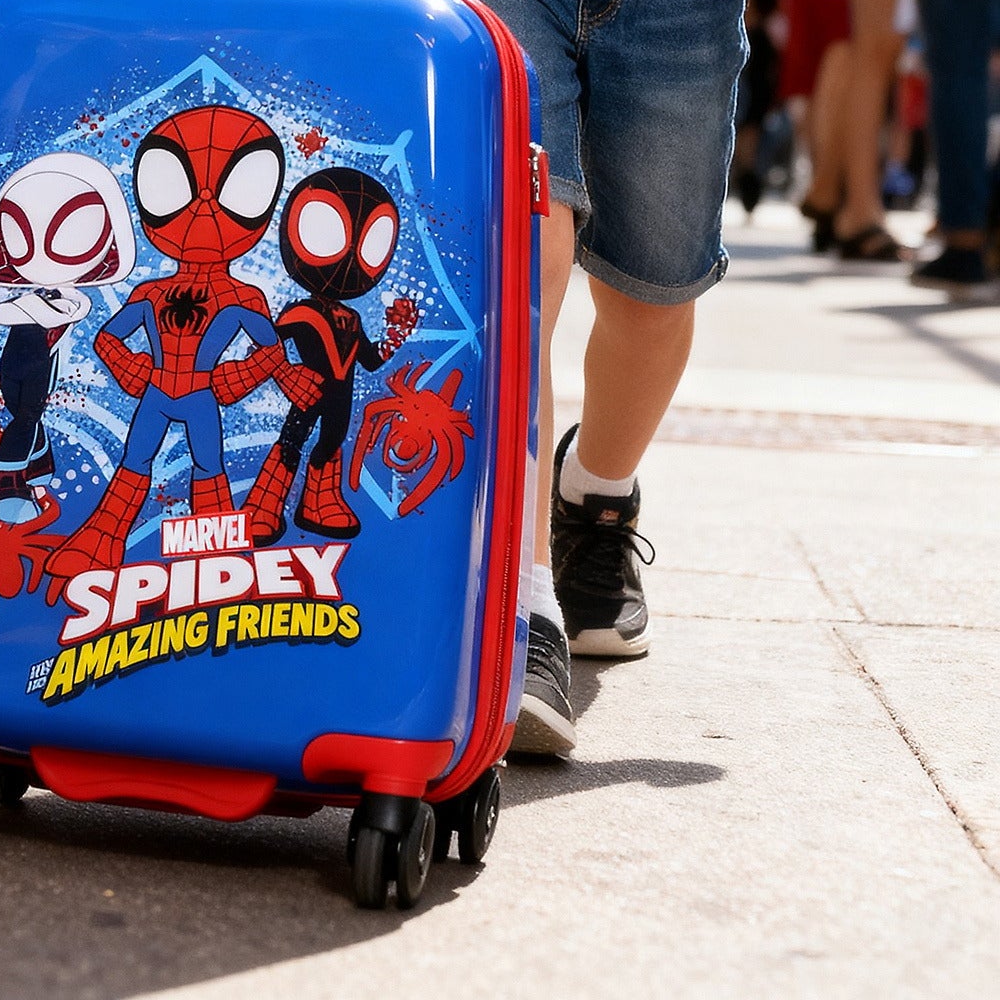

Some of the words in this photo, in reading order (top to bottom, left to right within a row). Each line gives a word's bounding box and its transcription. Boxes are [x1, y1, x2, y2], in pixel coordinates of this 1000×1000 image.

[162, 512, 251, 554] MARVEL
[60, 543, 350, 642] SPIDEY
[42, 611, 210, 700] AMAZING
[215, 602, 361, 648] FRIENDS
